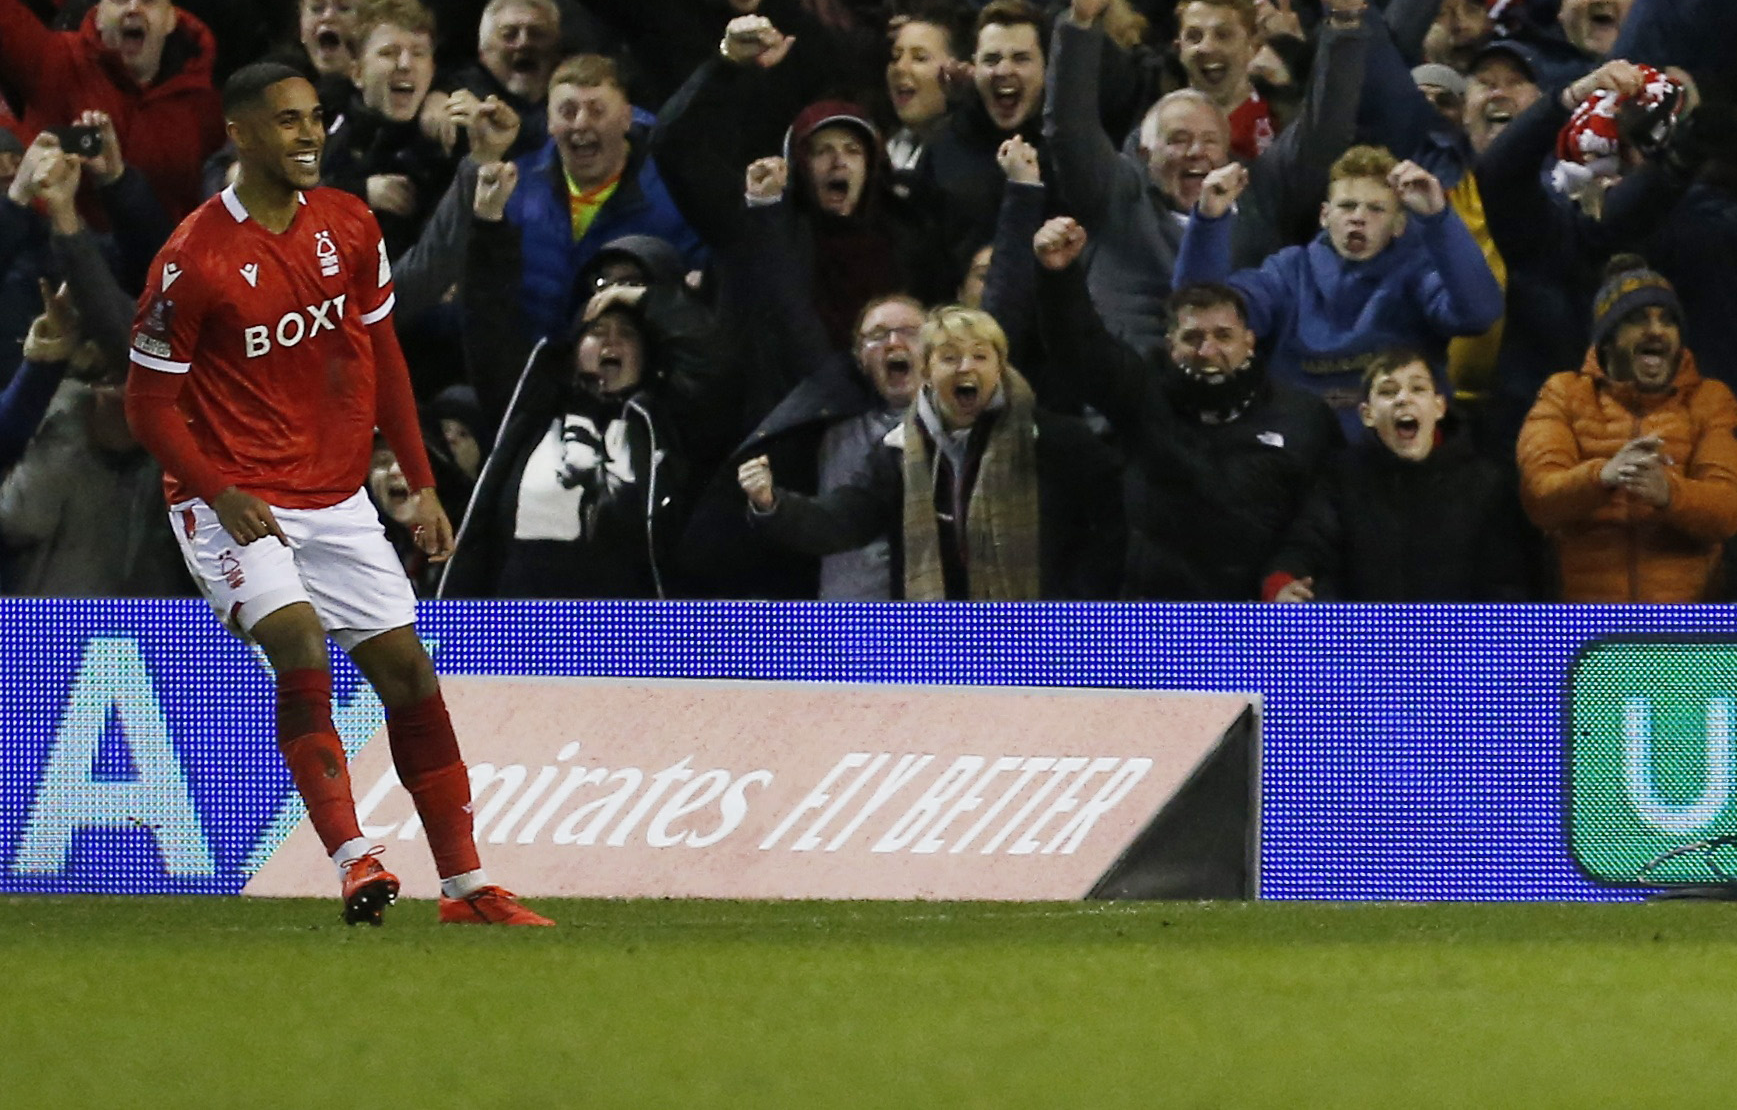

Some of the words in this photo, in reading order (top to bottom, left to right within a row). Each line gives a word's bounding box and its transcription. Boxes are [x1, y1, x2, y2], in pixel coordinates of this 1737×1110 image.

[758, 752, 936, 853] FLY
[871, 754, 1154, 856] BETTER
[1622, 695, 1737, 832] U
